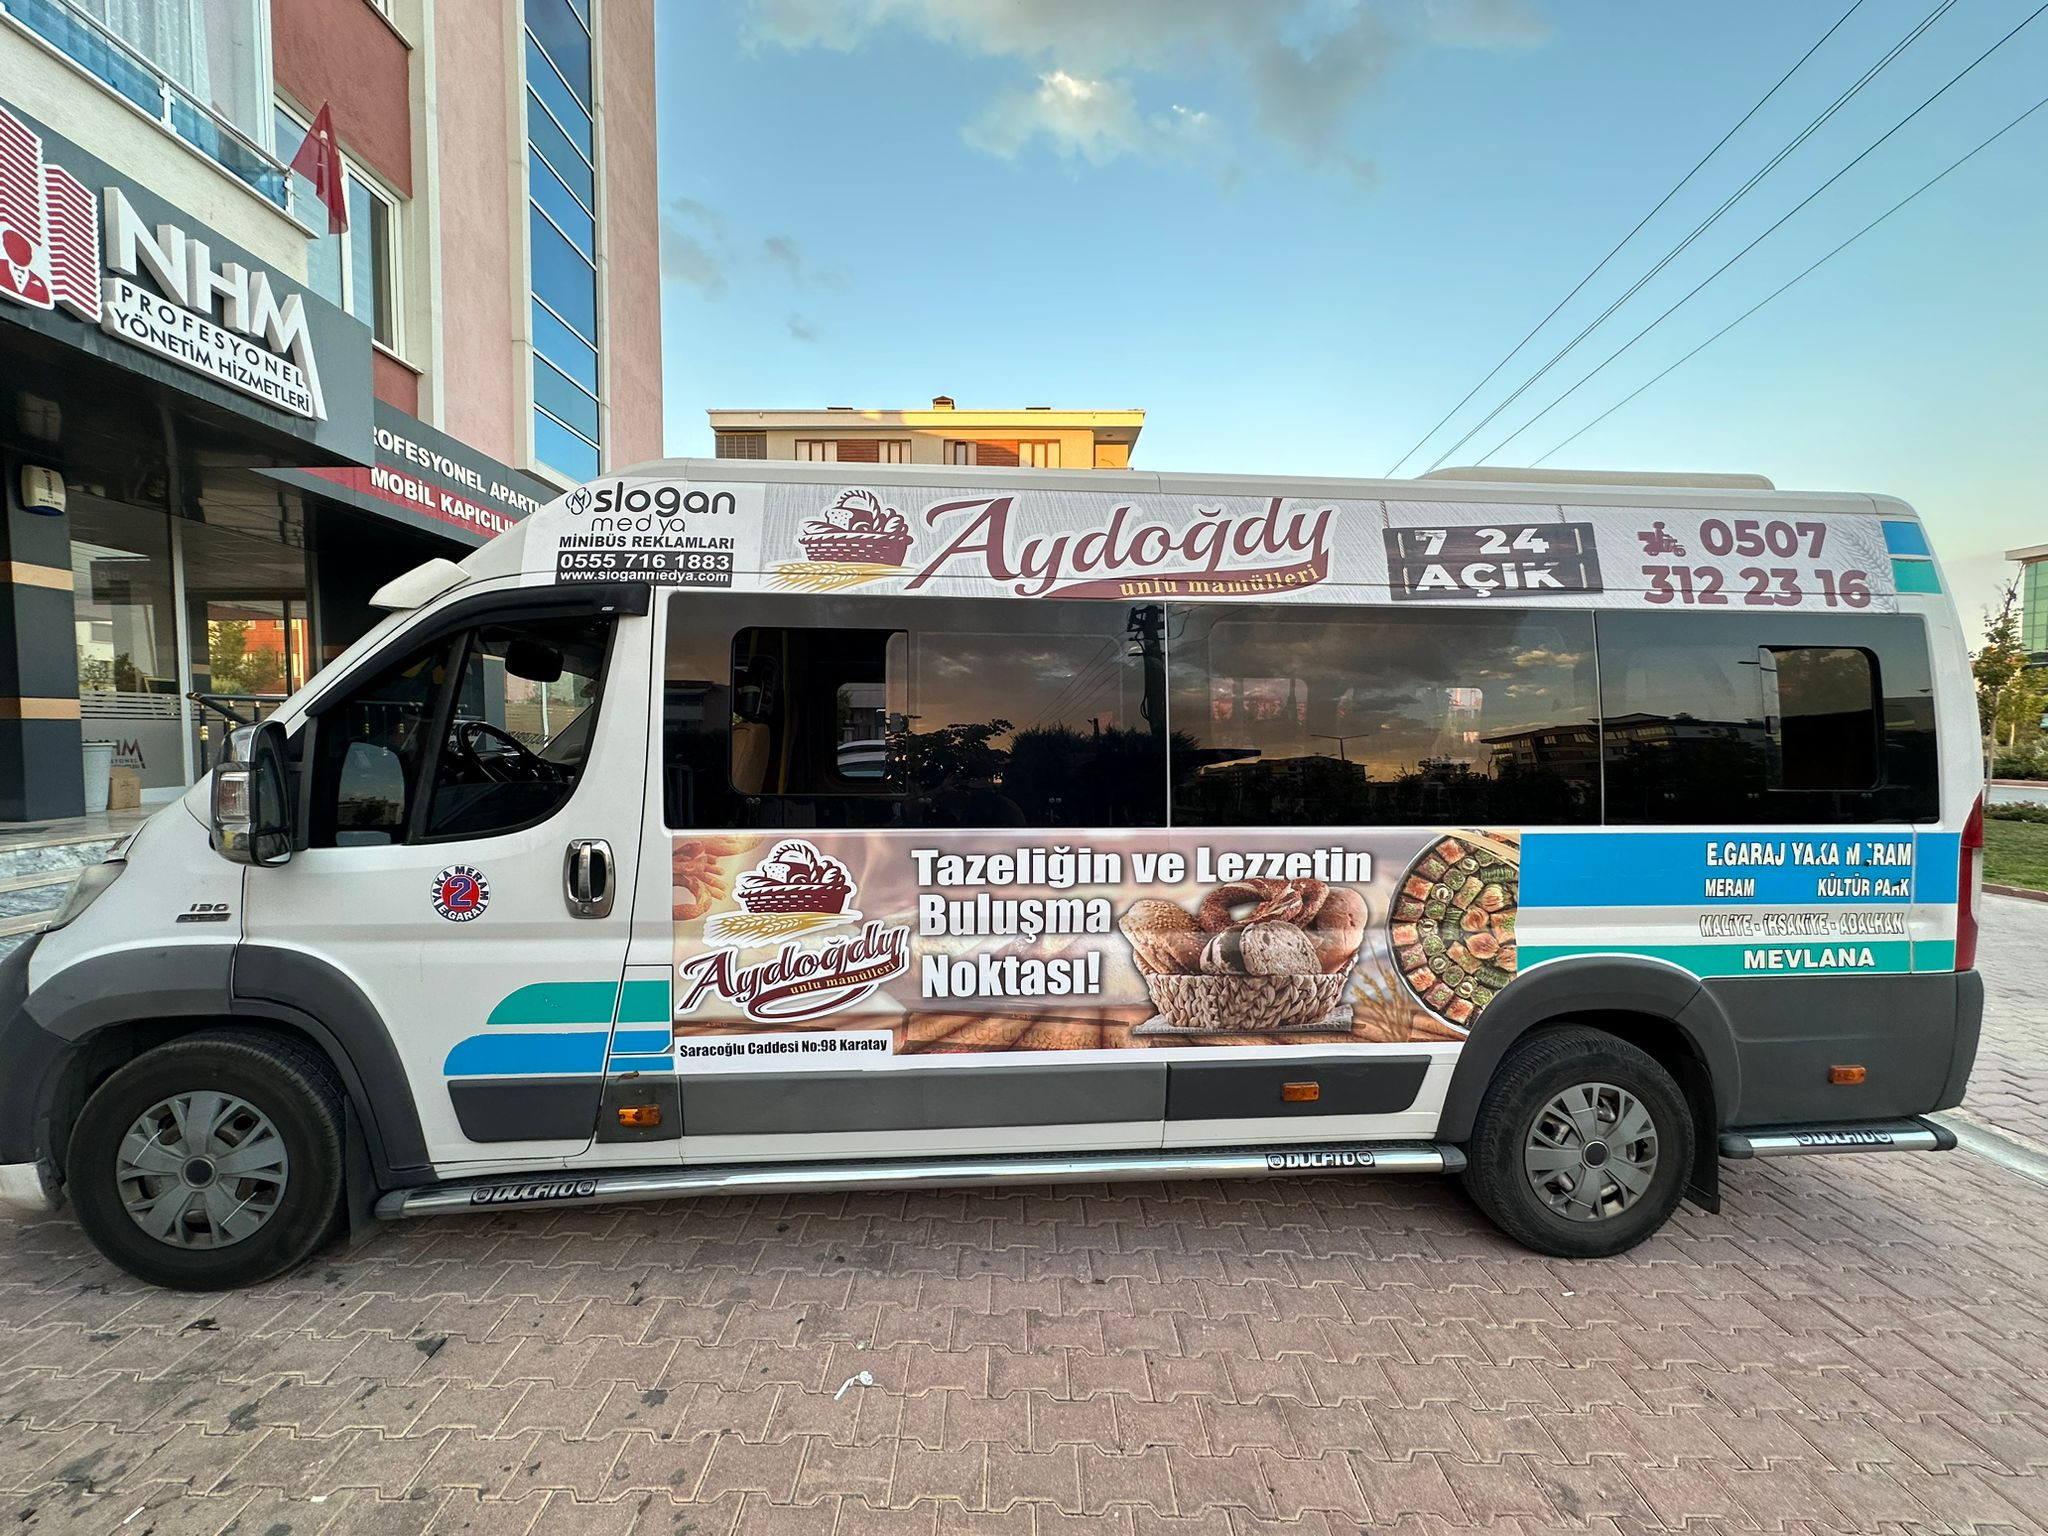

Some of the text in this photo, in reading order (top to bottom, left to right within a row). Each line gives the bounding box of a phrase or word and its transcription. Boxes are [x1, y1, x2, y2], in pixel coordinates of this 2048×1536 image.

[104, 187, 327, 421] NHM
[121, 286, 303, 388] PROFESYONEL
[116, 308, 310, 412] YÖNETİM HİZMETLERİ
[371, 467, 436, 507] MOBİL
[593, 481, 736, 518] slogan
[591, 514, 686, 535] medya
[1699, 518, 1827, 558] 0507
[559, 533, 735, 550] MİNİBÜS REKLAMLARI
[1414, 528, 1550, 555] 7 24
[560, 553, 730, 570] 0555 716 1883
[560, 569, 729, 583] www.sloganmedya.com
[1120, 564, 1319, 596] unlu mamülleri
[1642, 566, 1872, 608] 312 23 16
[911, 845, 1371, 887] Tazeliğin ve Lezzetin
[1706, 842, 1912, 866] E.GARAJ YAKA MRAM
[432, 866, 489, 903] YAKA MERAM
[450, 877, 472, 907] 2
[1705, 878, 1755, 897] MERAM
[1817, 873, 1870, 897] KÜLTÜR
[438, 903, 485, 921] E.GARAJ
[919, 893, 1111, 942] Buluşma
[1743, 948, 1876, 970] MEVLANA
[789, 961, 897, 995] unlu mamülleri
[921, 951, 1101, 999] Noktası!
[680, 1038, 887, 1058] Saracoğlu Caddesi No:98 Karatay
[1286, 1151, 1355, 1168] DUCATO
[492, 1181, 577, 1202] DUCATO
